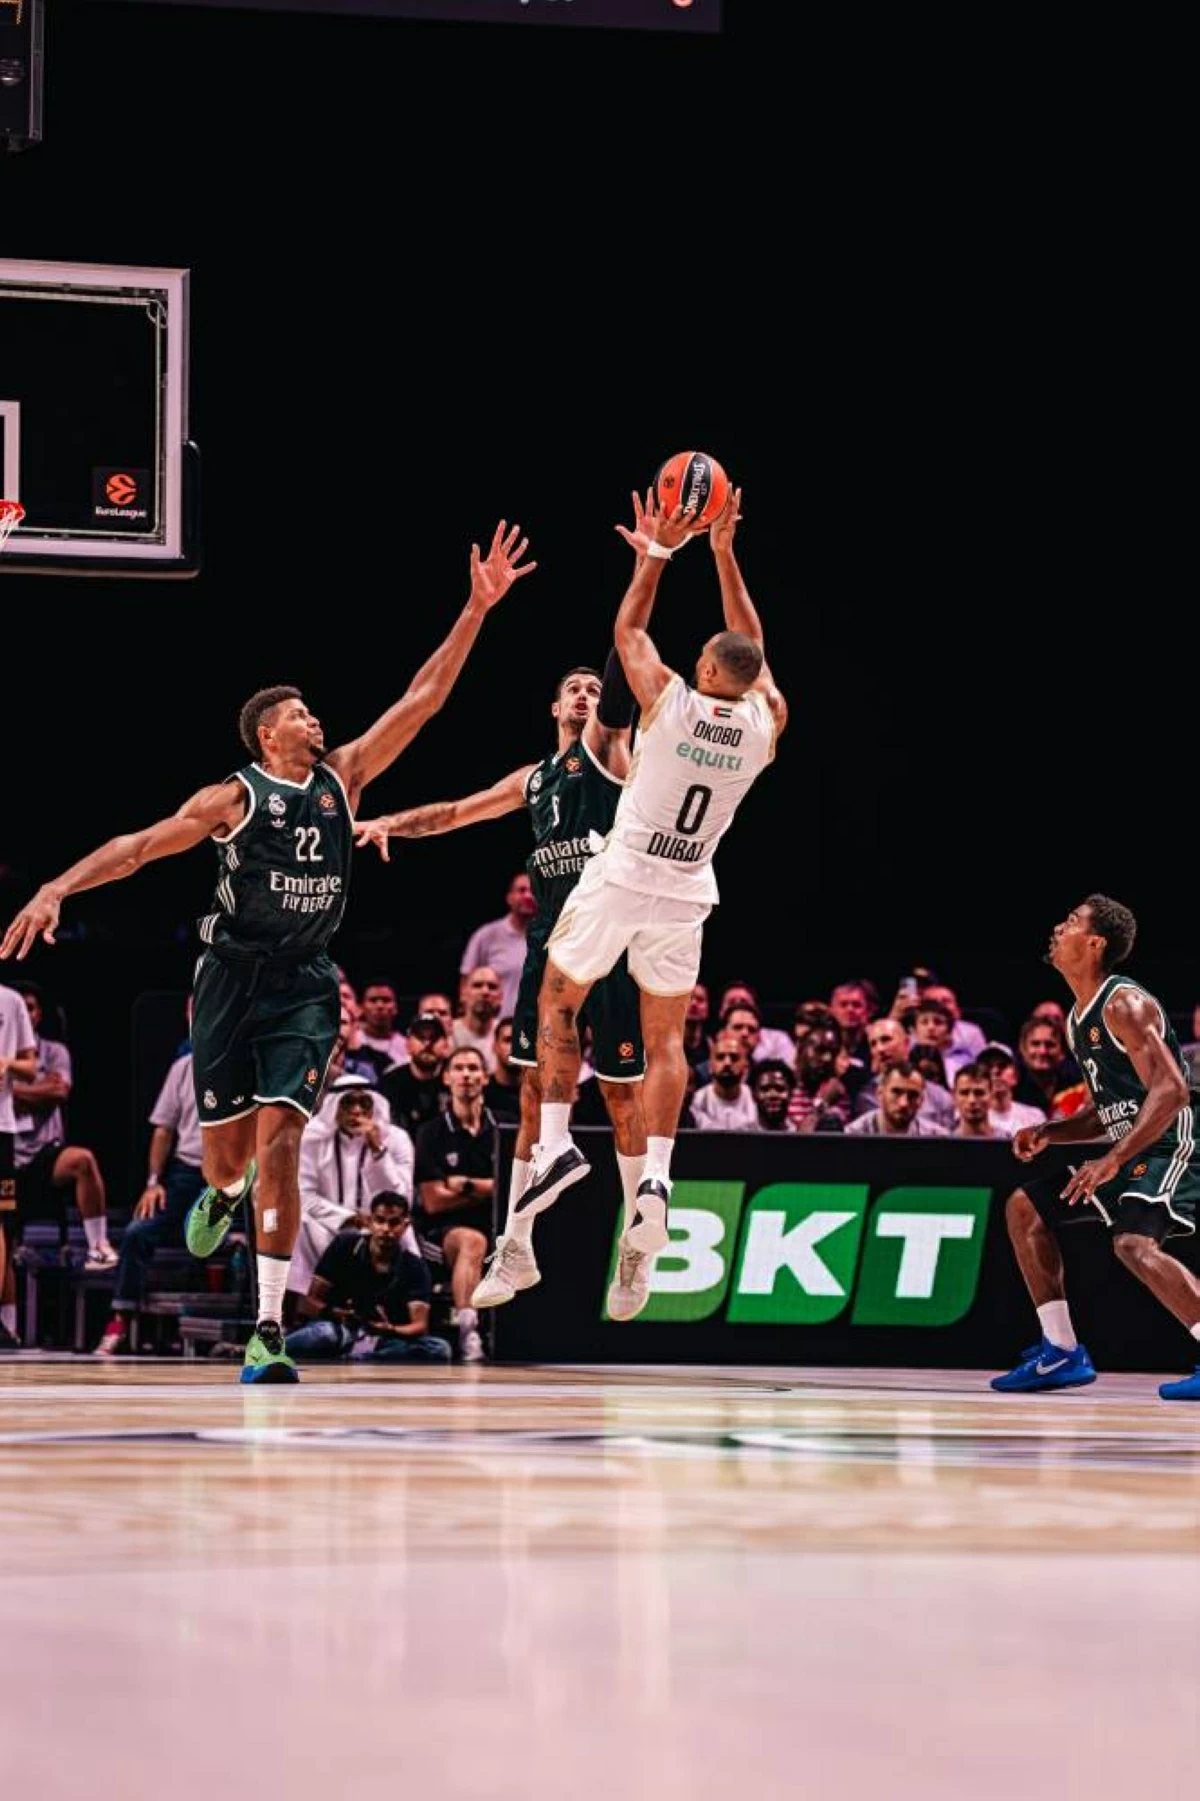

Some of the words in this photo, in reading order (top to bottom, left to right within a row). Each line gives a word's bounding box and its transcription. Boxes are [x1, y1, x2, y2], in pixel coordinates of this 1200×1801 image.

[694, 720, 743, 747] OKOBO
[676, 741, 744, 771] equiti
[675, 783, 713, 835] 0
[295, 826, 324, 862] 22
[532, 837, 590, 867] mirate
[647, 832, 704, 862] DUBAI
[270, 870, 342, 894] Emirate
[648, 1208, 977, 1299] BKT
